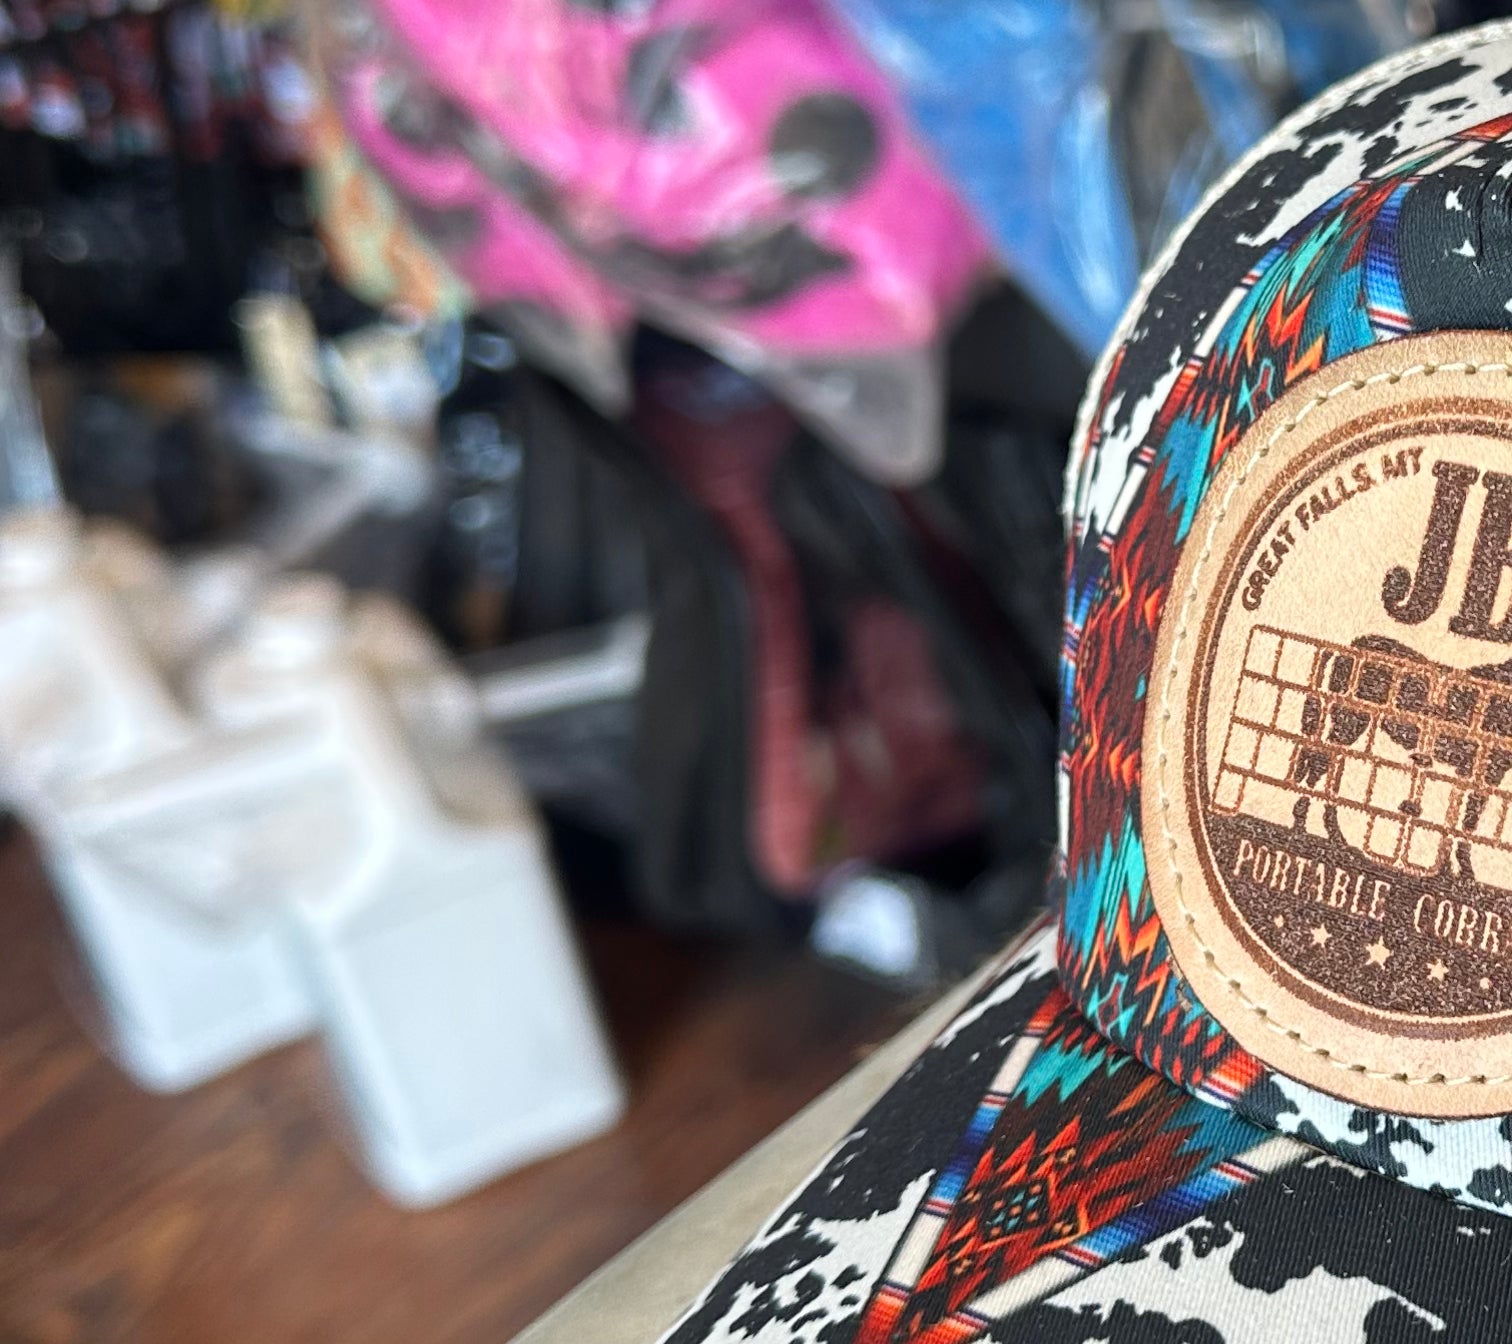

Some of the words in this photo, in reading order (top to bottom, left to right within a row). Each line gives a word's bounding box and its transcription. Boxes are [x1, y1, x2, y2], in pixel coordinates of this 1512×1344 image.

[1242, 520, 1296, 611] GREAT
[1381, 445, 1425, 482] MT
[1233, 839, 1391, 922] PORTABLE
